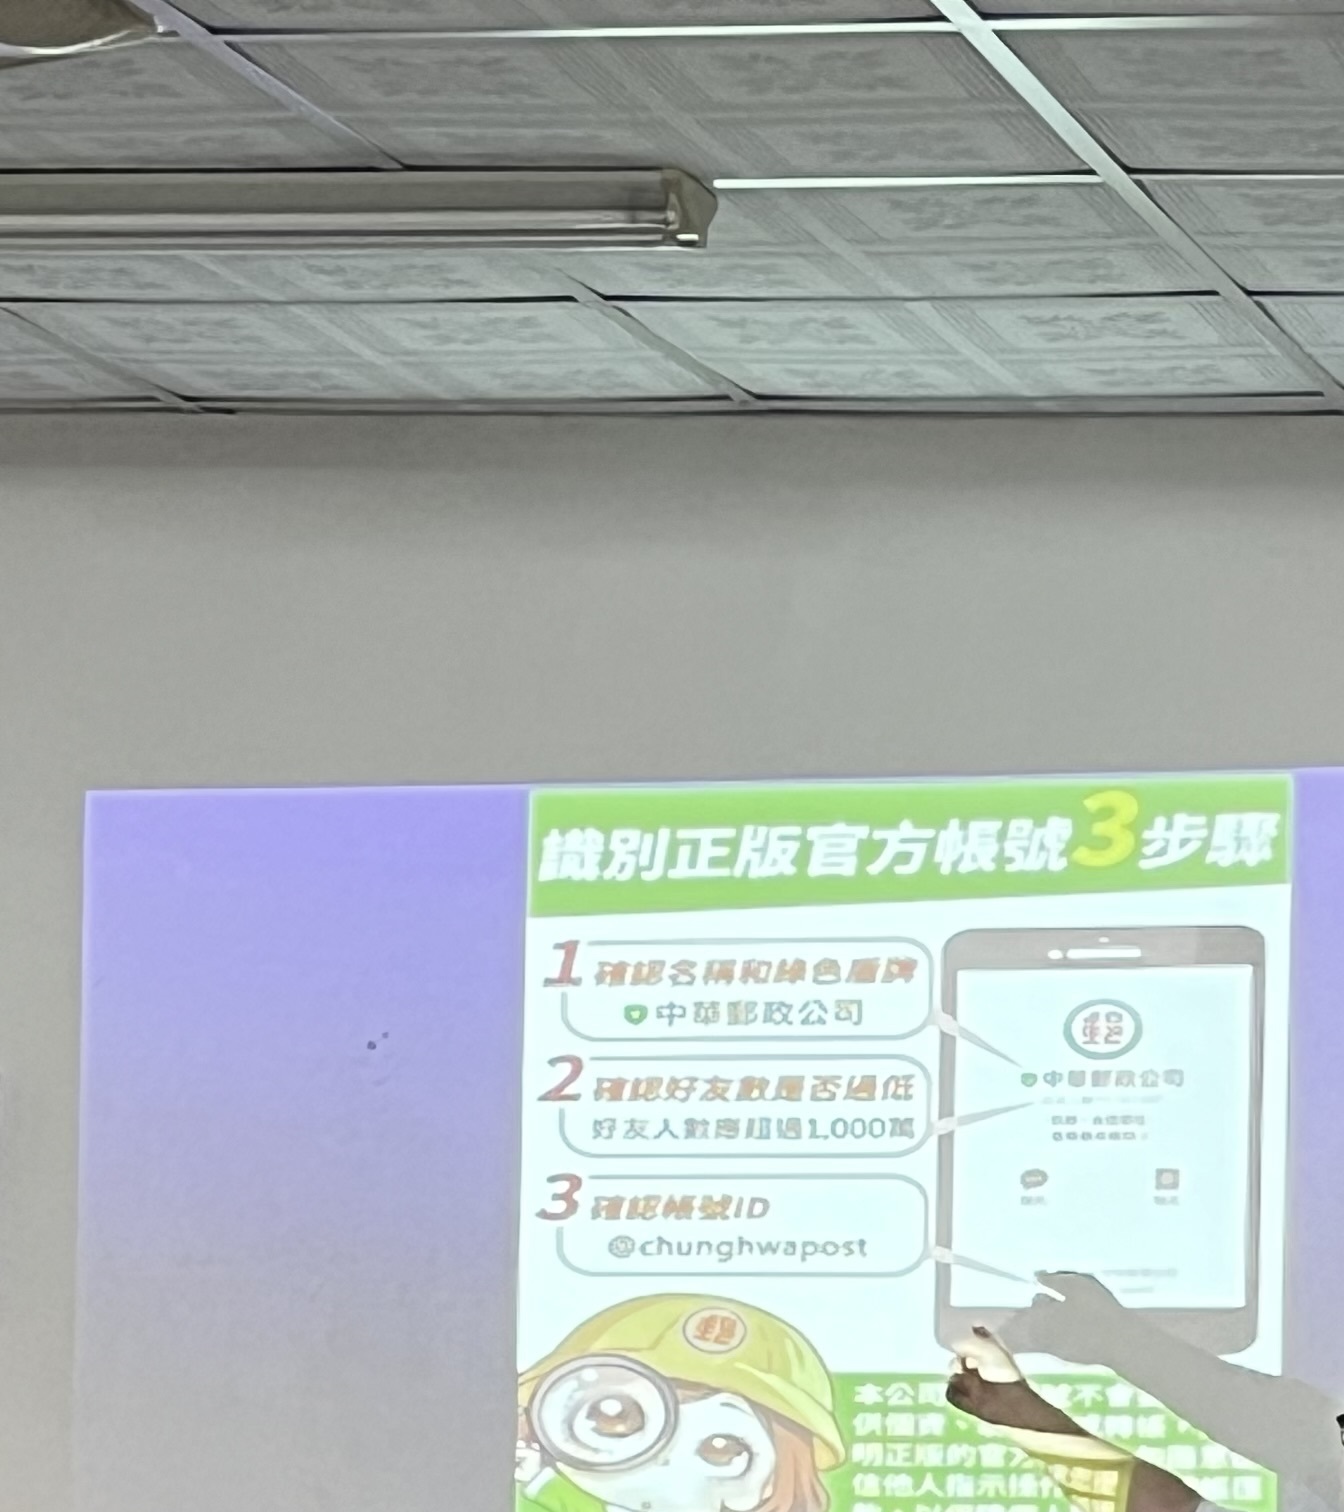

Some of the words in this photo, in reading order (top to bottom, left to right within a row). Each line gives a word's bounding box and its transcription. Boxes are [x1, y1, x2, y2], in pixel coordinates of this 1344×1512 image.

[543, 940, 582, 987] 1
[537, 1054, 585, 1101] 2
[535, 1173, 583, 1222] 3
[607, 1234, 869, 1263] @chunghwapost
